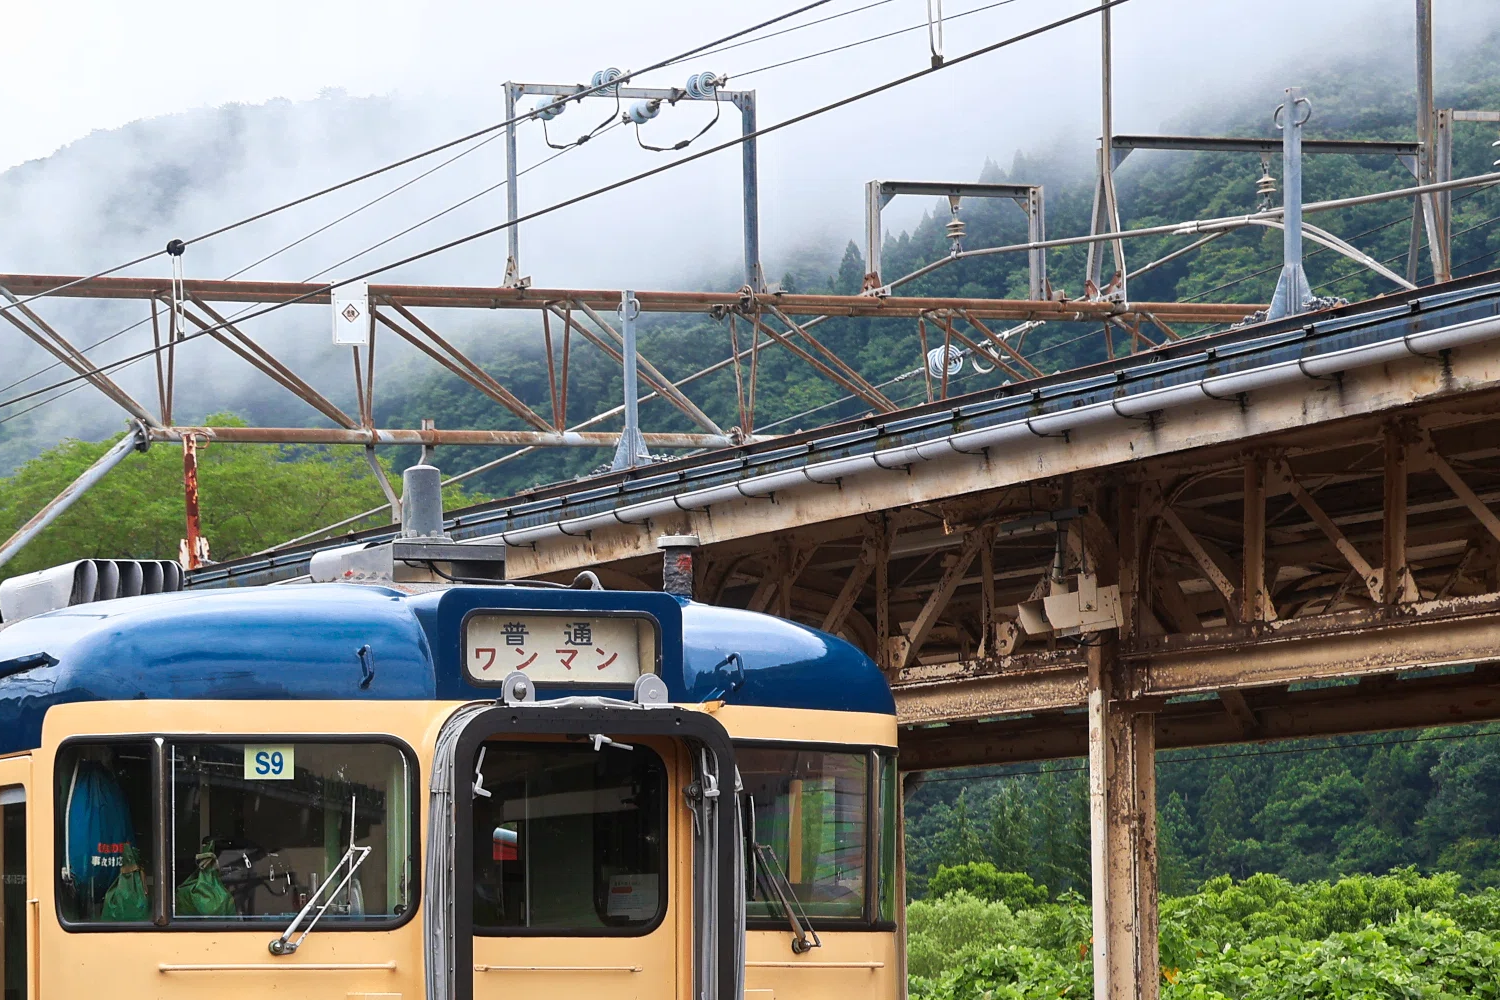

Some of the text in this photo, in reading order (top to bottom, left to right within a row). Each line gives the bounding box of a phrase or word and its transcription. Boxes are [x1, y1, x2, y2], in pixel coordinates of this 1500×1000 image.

[500, 621, 593, 646] 普通
[475, 647, 618, 670] ワンマン
[255, 751, 284, 775] S9
